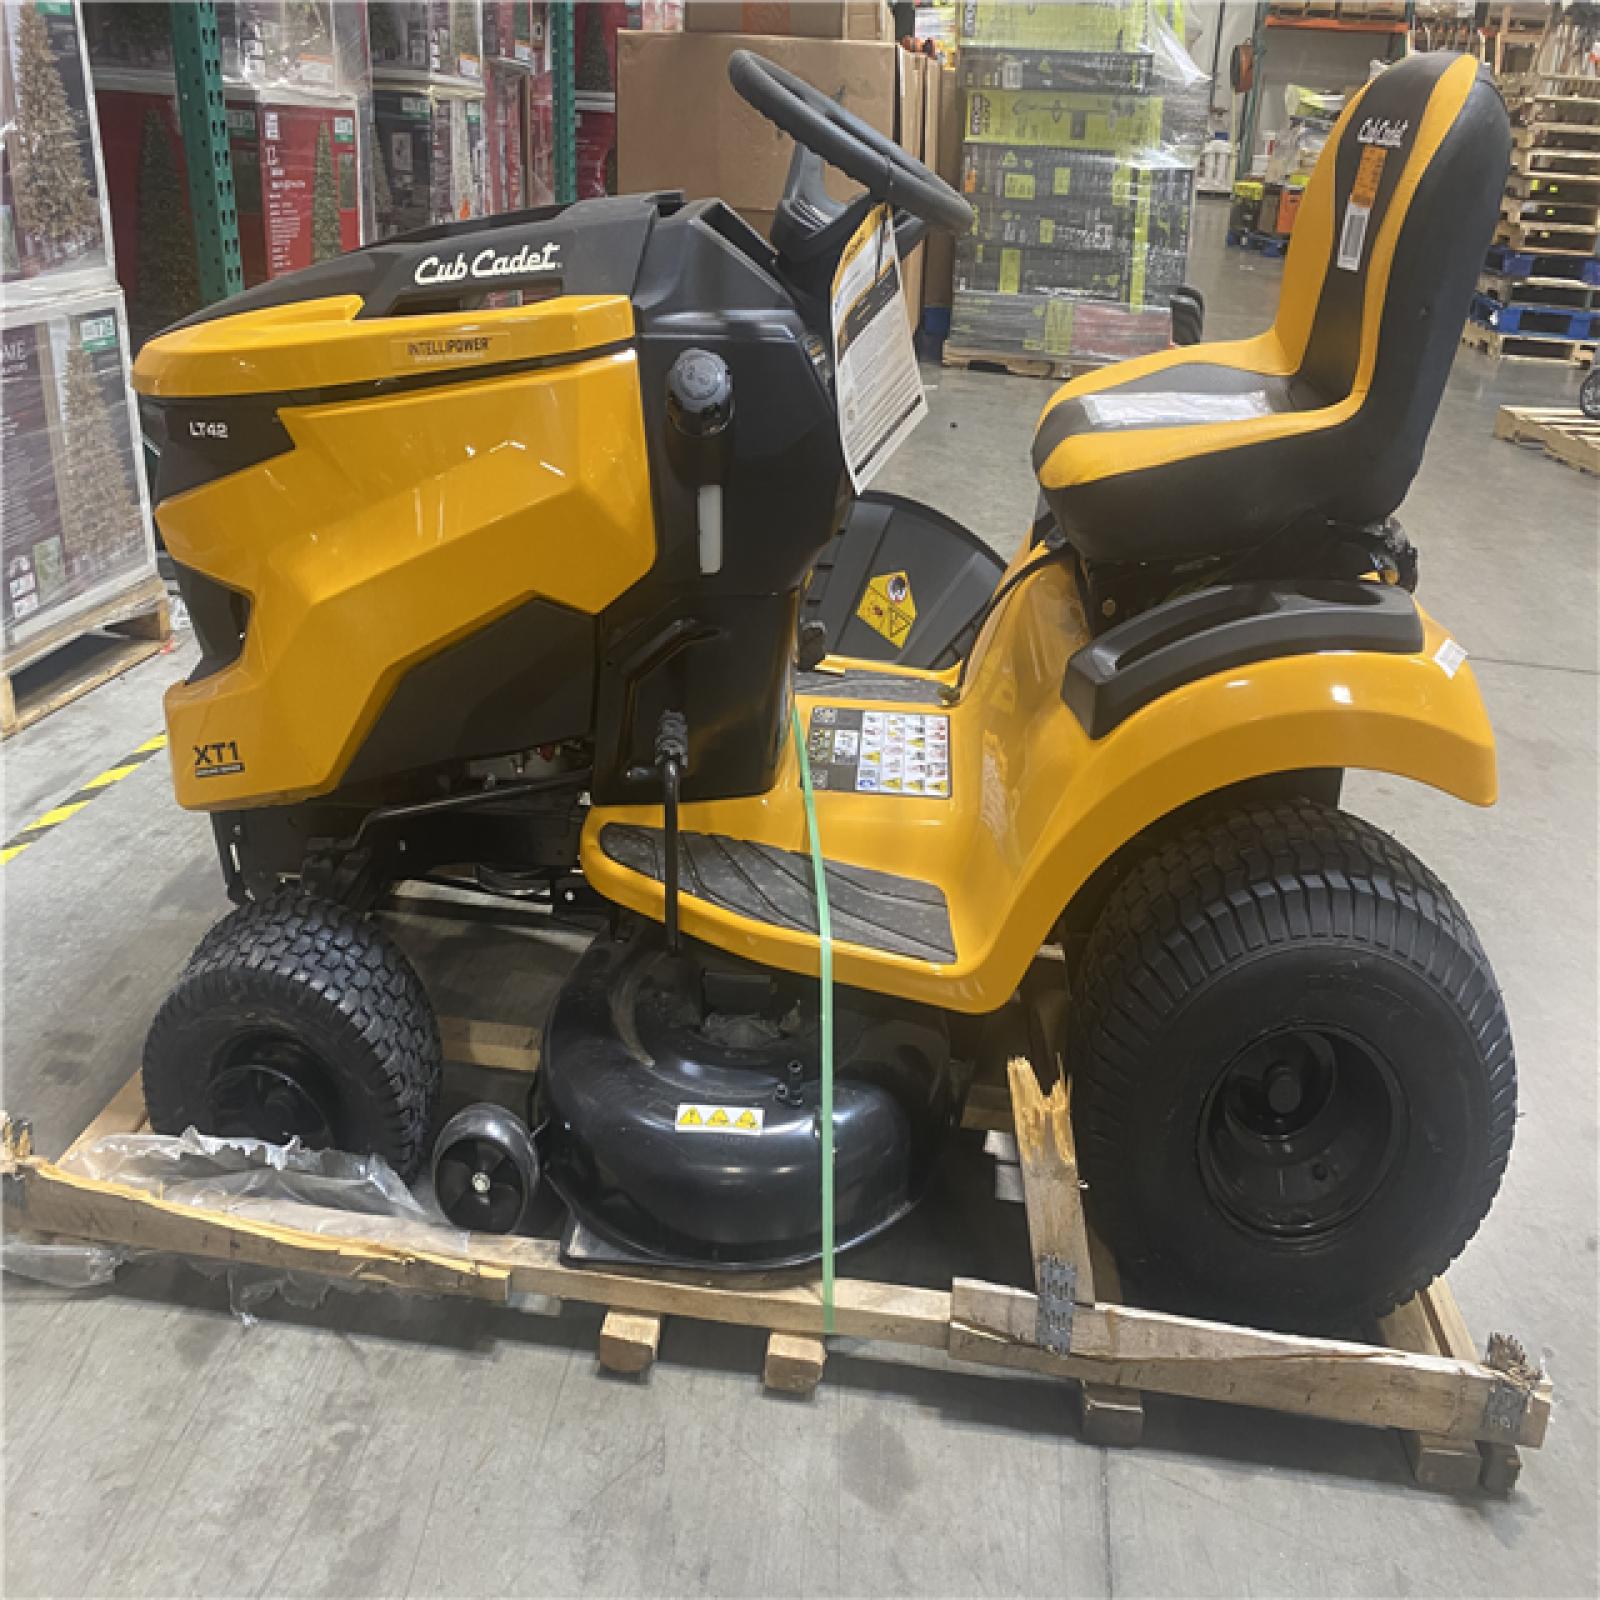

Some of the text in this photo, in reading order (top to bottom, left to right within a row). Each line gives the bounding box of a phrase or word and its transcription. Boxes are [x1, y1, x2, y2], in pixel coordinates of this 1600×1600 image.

[415, 242, 561, 285] Cub Cadet
[408, 337, 489, 355] INTELLIPOWER
[189, 420, 228, 439] LT42
[193, 740, 239, 766] XT1
